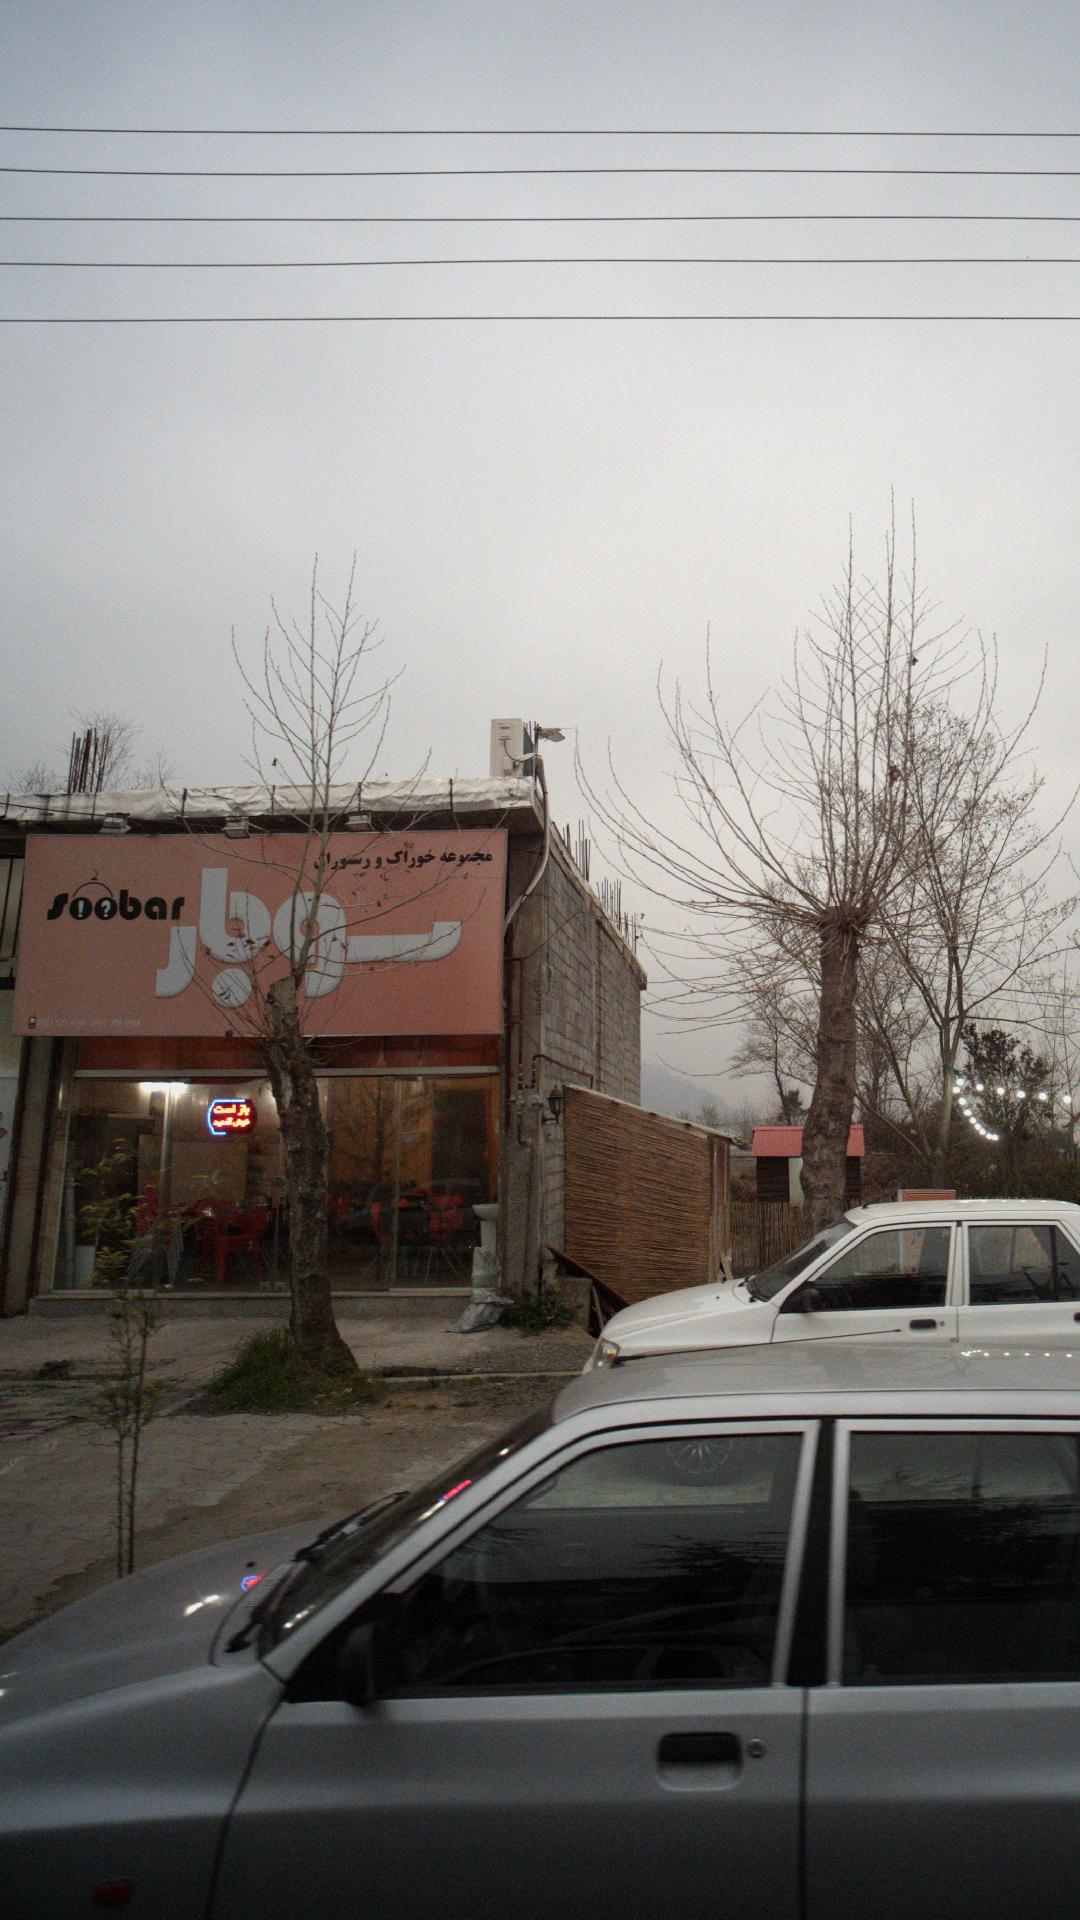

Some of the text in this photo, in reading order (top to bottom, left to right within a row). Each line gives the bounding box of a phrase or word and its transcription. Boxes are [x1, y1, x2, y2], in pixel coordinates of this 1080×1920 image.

[374, 855, 383, 869] و
[386, 849, 436, 868] خوراک
[440, 850, 493, 867] مجموعه
[46, 889, 186, 921] soobar
[155, 867, 462, 1009] سوبار
[213, 1104, 251, 1116] باز است
